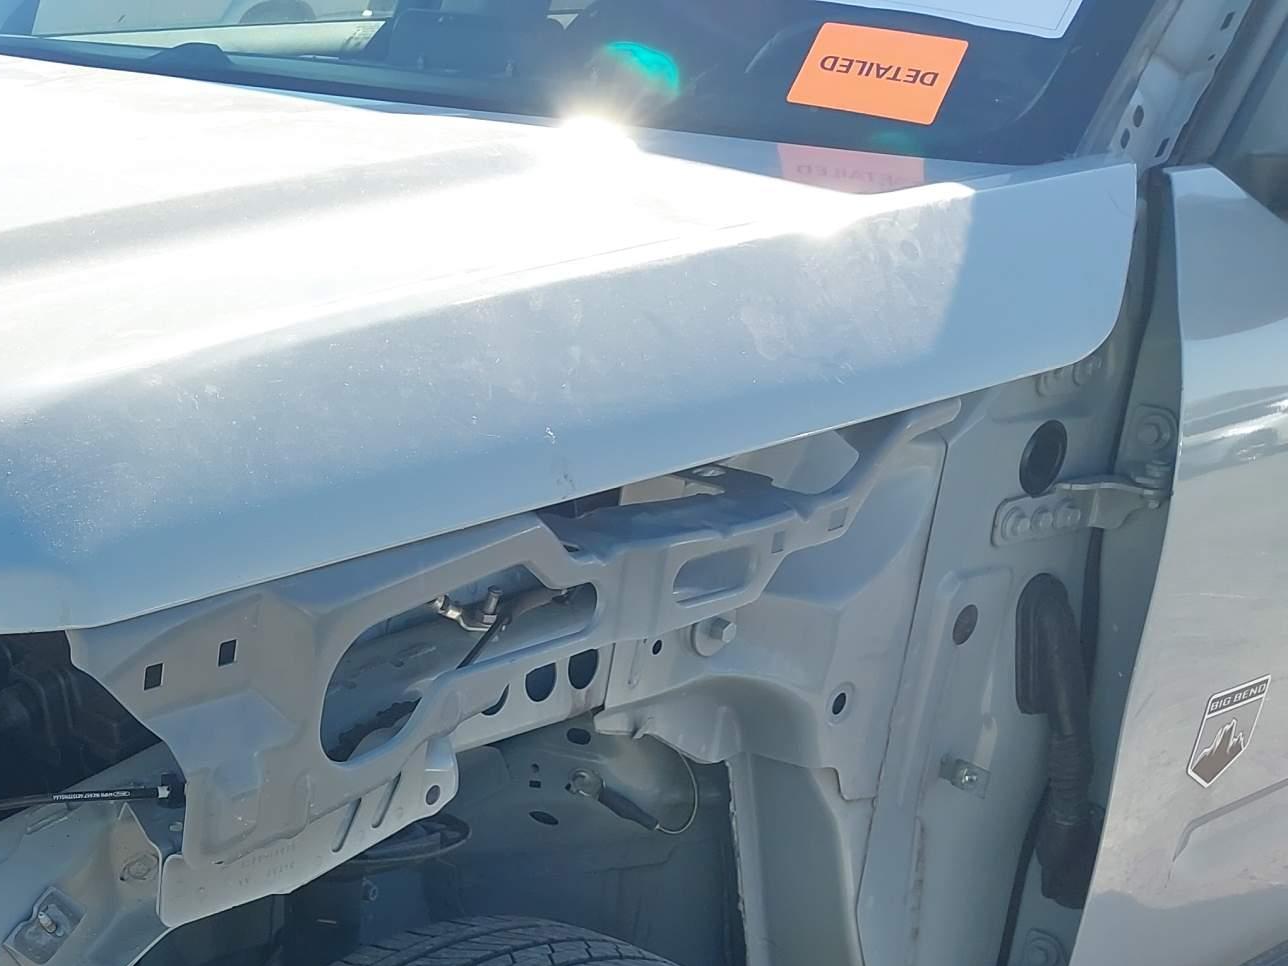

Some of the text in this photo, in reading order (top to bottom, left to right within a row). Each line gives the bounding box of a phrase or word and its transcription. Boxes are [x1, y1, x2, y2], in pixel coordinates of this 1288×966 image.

[819, 55, 939, 87] DETAILED
[1210, 682, 1267, 712] BIG BEND
